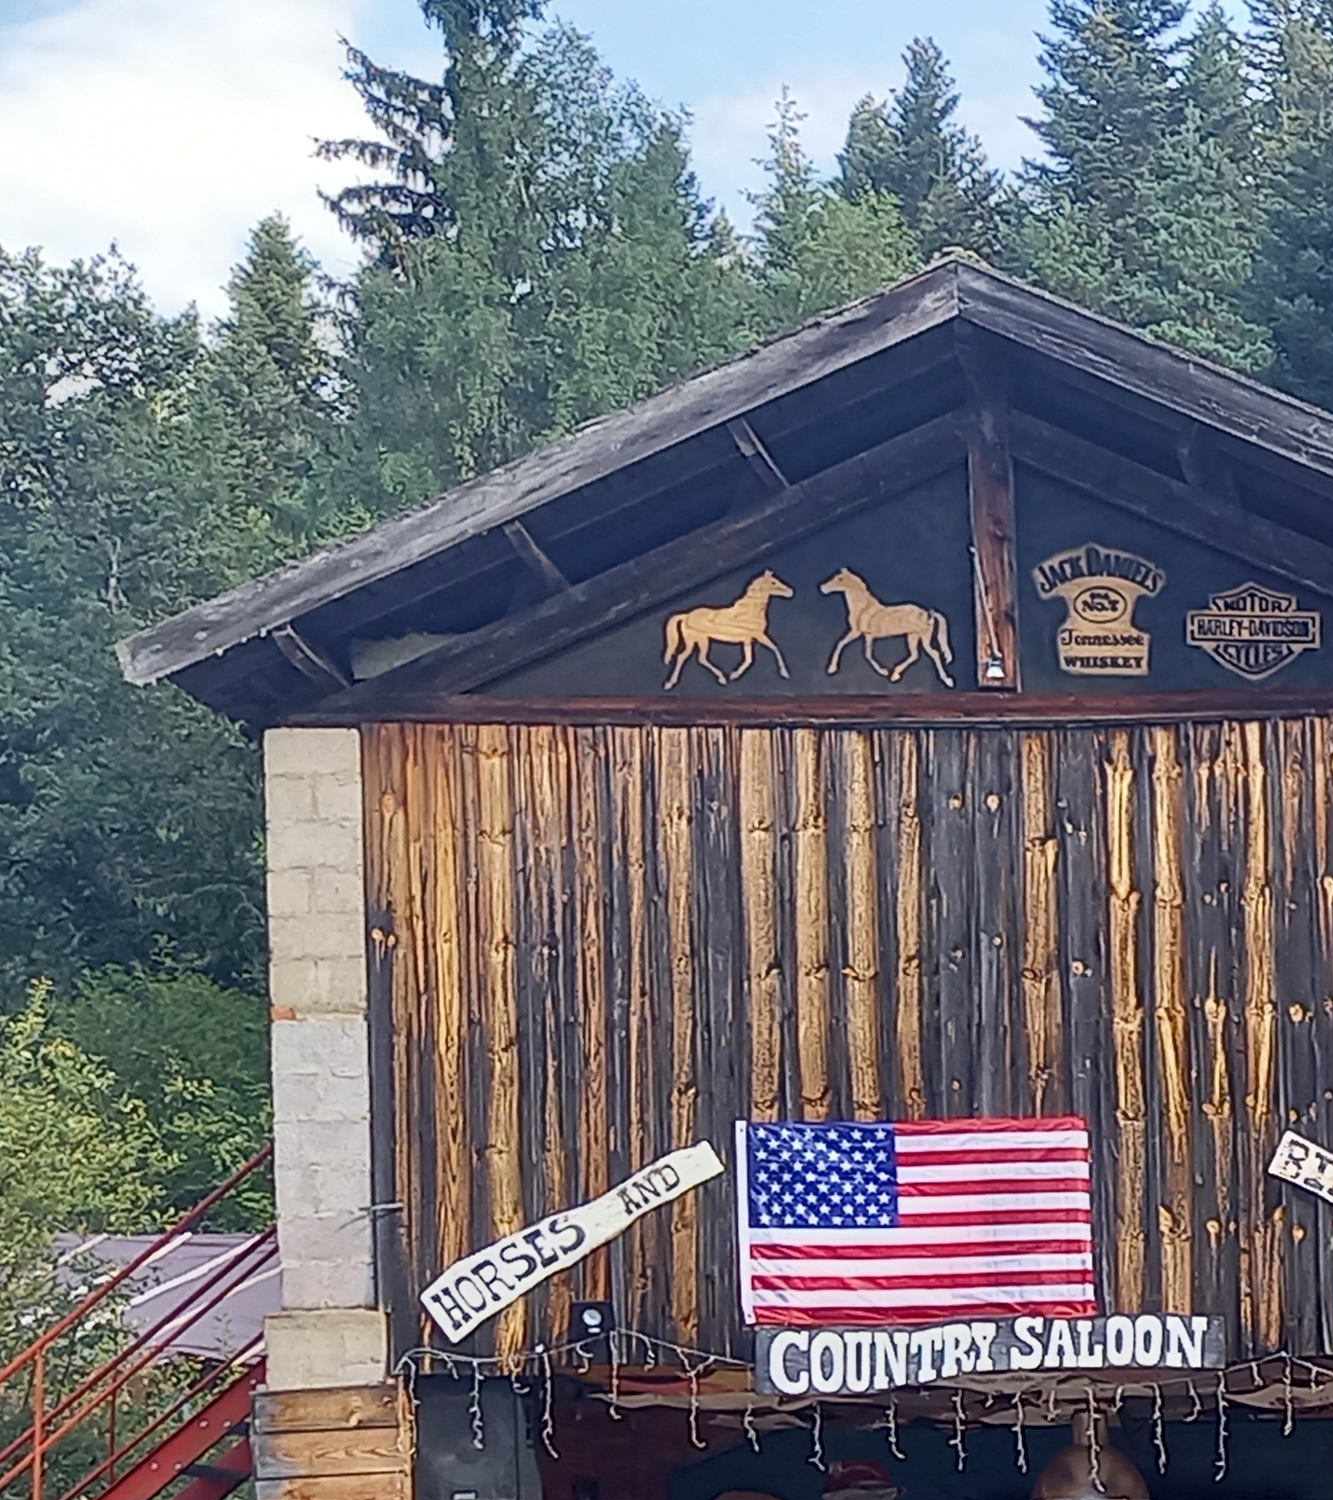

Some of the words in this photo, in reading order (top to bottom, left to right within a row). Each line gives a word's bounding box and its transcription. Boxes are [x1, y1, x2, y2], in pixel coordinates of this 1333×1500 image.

[1038, 556, 1082, 593] JACK
[1223, 593, 1282, 612] MOTOR
[1197, 618, 1310, 638] HARLEY-DAVIDSON
[1063, 655, 1144, 669] WHISKEY
[1222, 643, 1284, 670] CYCLES
[430, 1215, 586, 1332] HORSES
[616, 1163, 681, 1215] AND
[768, 1321, 998, 1395] COUNTRY
[1009, 1315, 1208, 1370] SALOON
